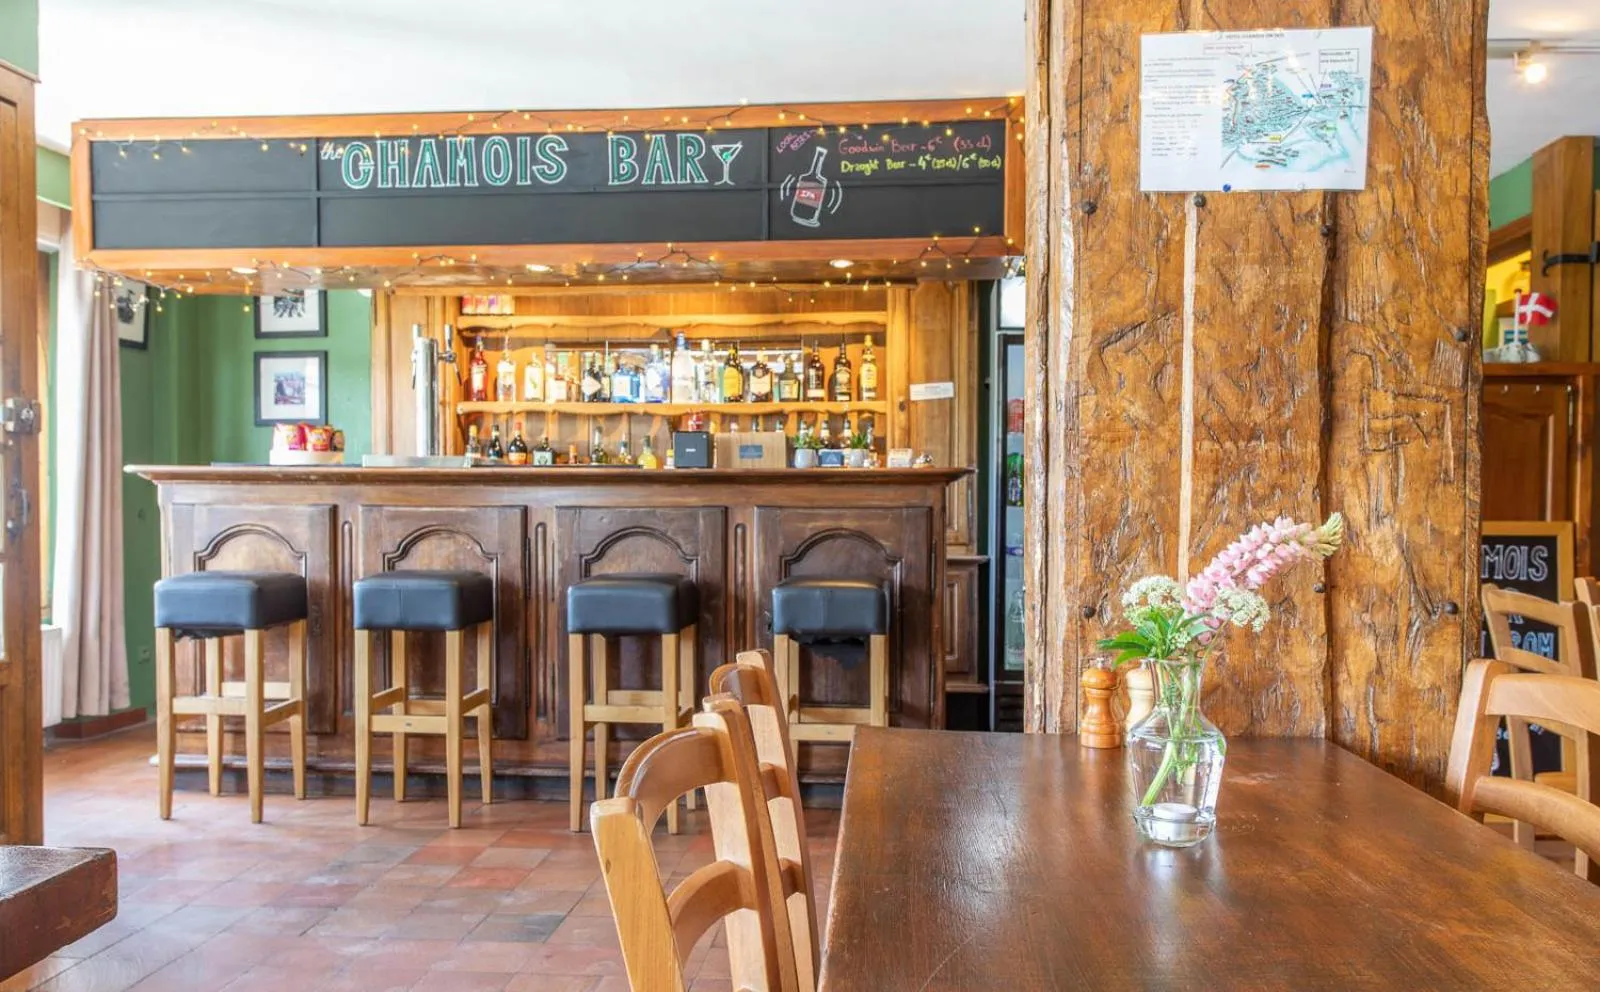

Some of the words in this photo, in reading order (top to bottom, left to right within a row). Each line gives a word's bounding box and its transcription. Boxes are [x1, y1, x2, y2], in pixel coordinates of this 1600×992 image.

[320, 141, 344, 160] the
[341, 134, 569, 190] CHAMOIS
[607, 133, 709, 186] BAR
[1481, 543, 1548, 582] MOIS
